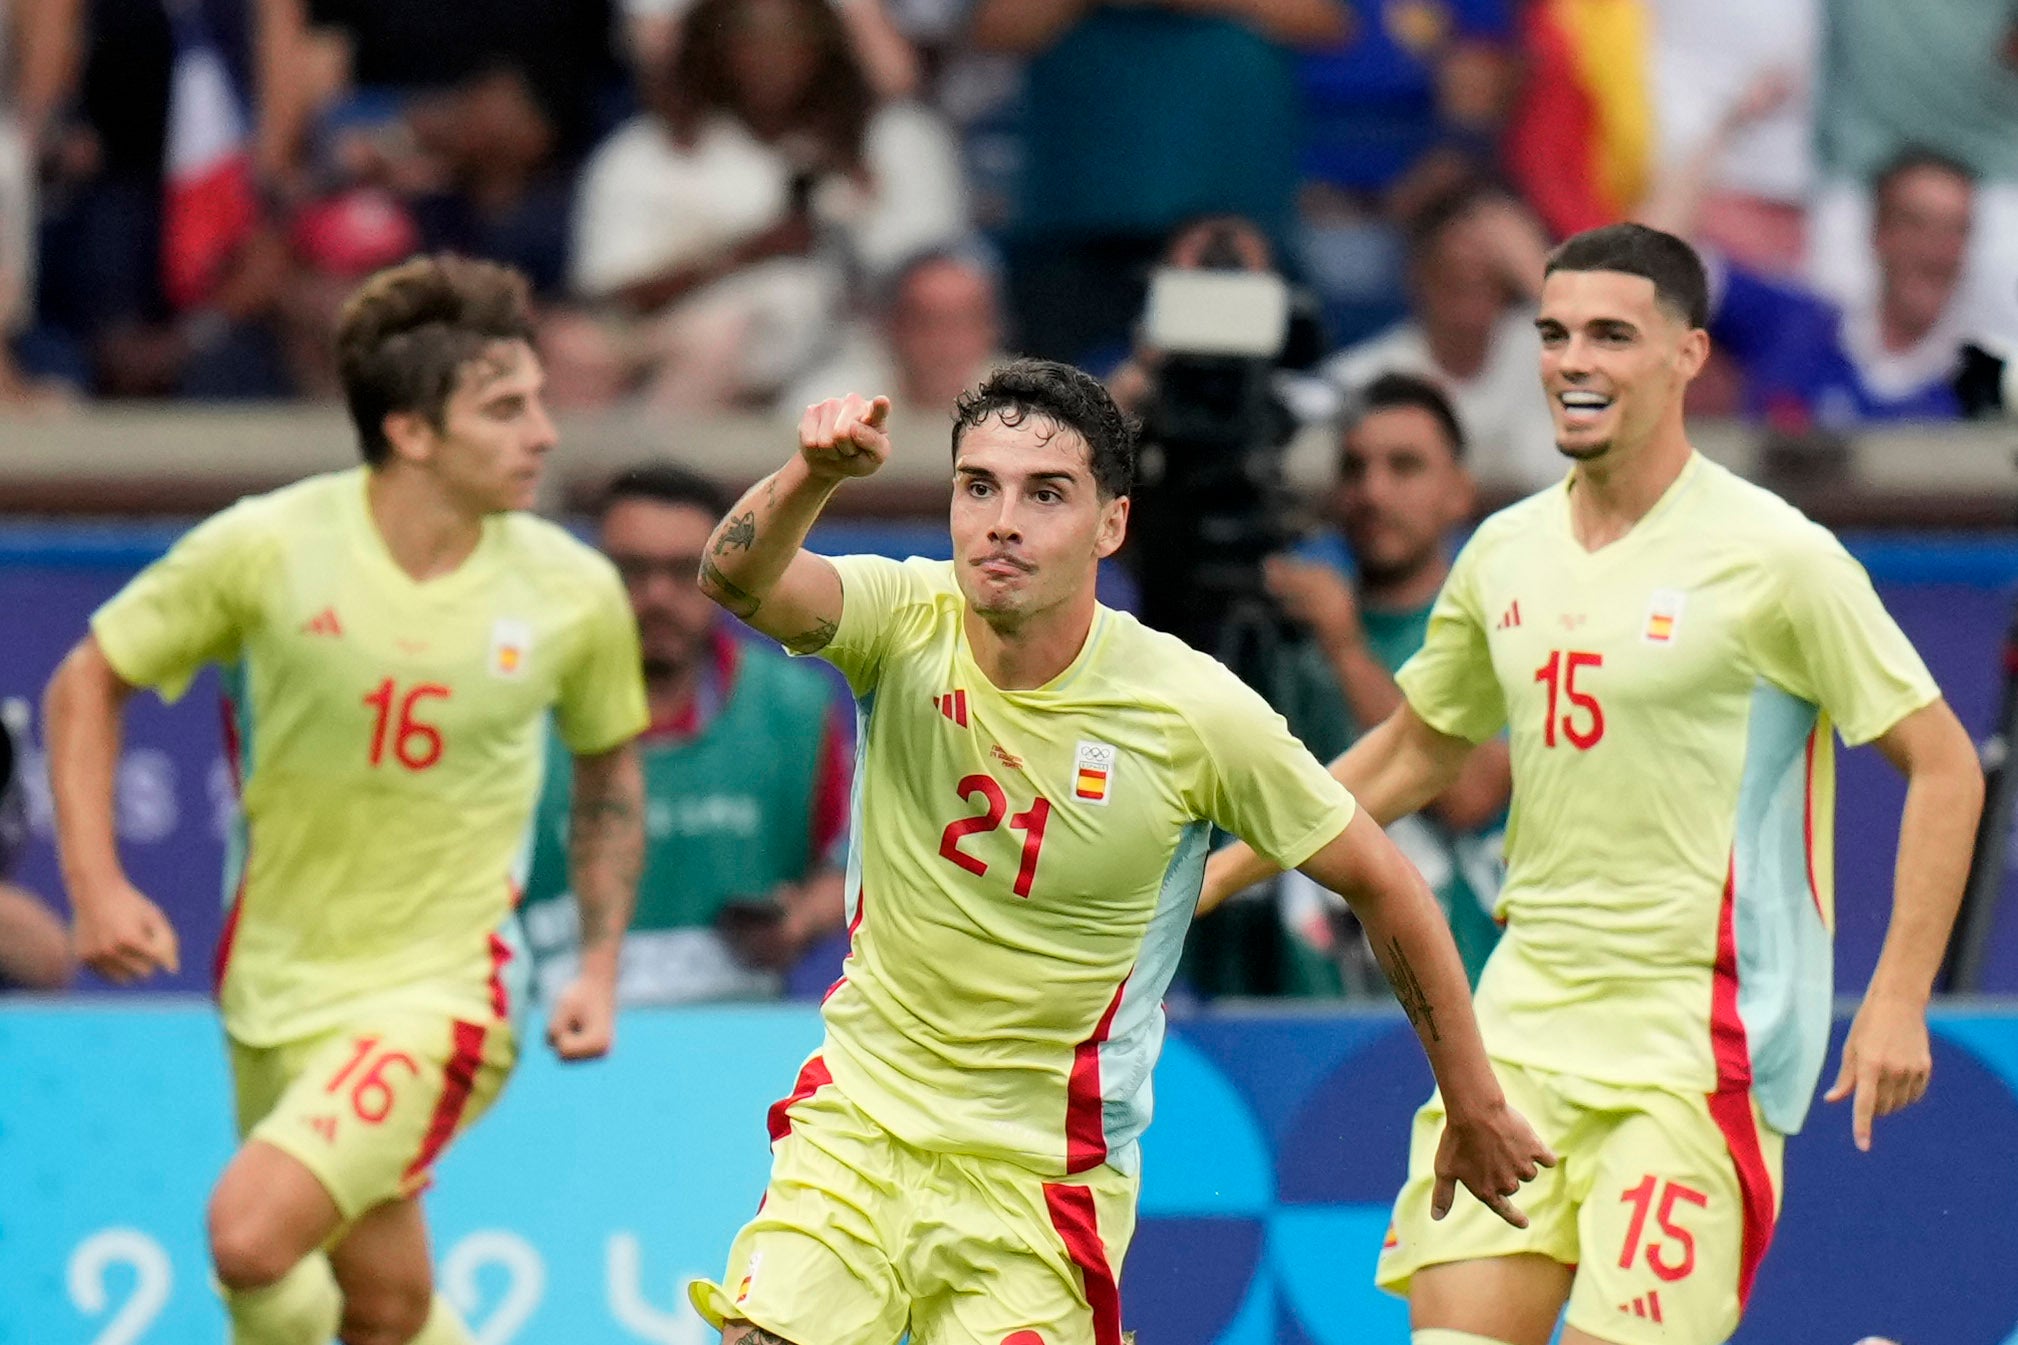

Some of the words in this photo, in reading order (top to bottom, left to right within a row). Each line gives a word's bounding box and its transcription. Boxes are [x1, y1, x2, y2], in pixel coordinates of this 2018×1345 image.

[363, 677, 452, 773] 16
[1534, 650, 1606, 752] 15
[938, 773, 1052, 899] 21
[325, 1036, 420, 1126] 16
[1618, 1174, 1709, 1283] 15
